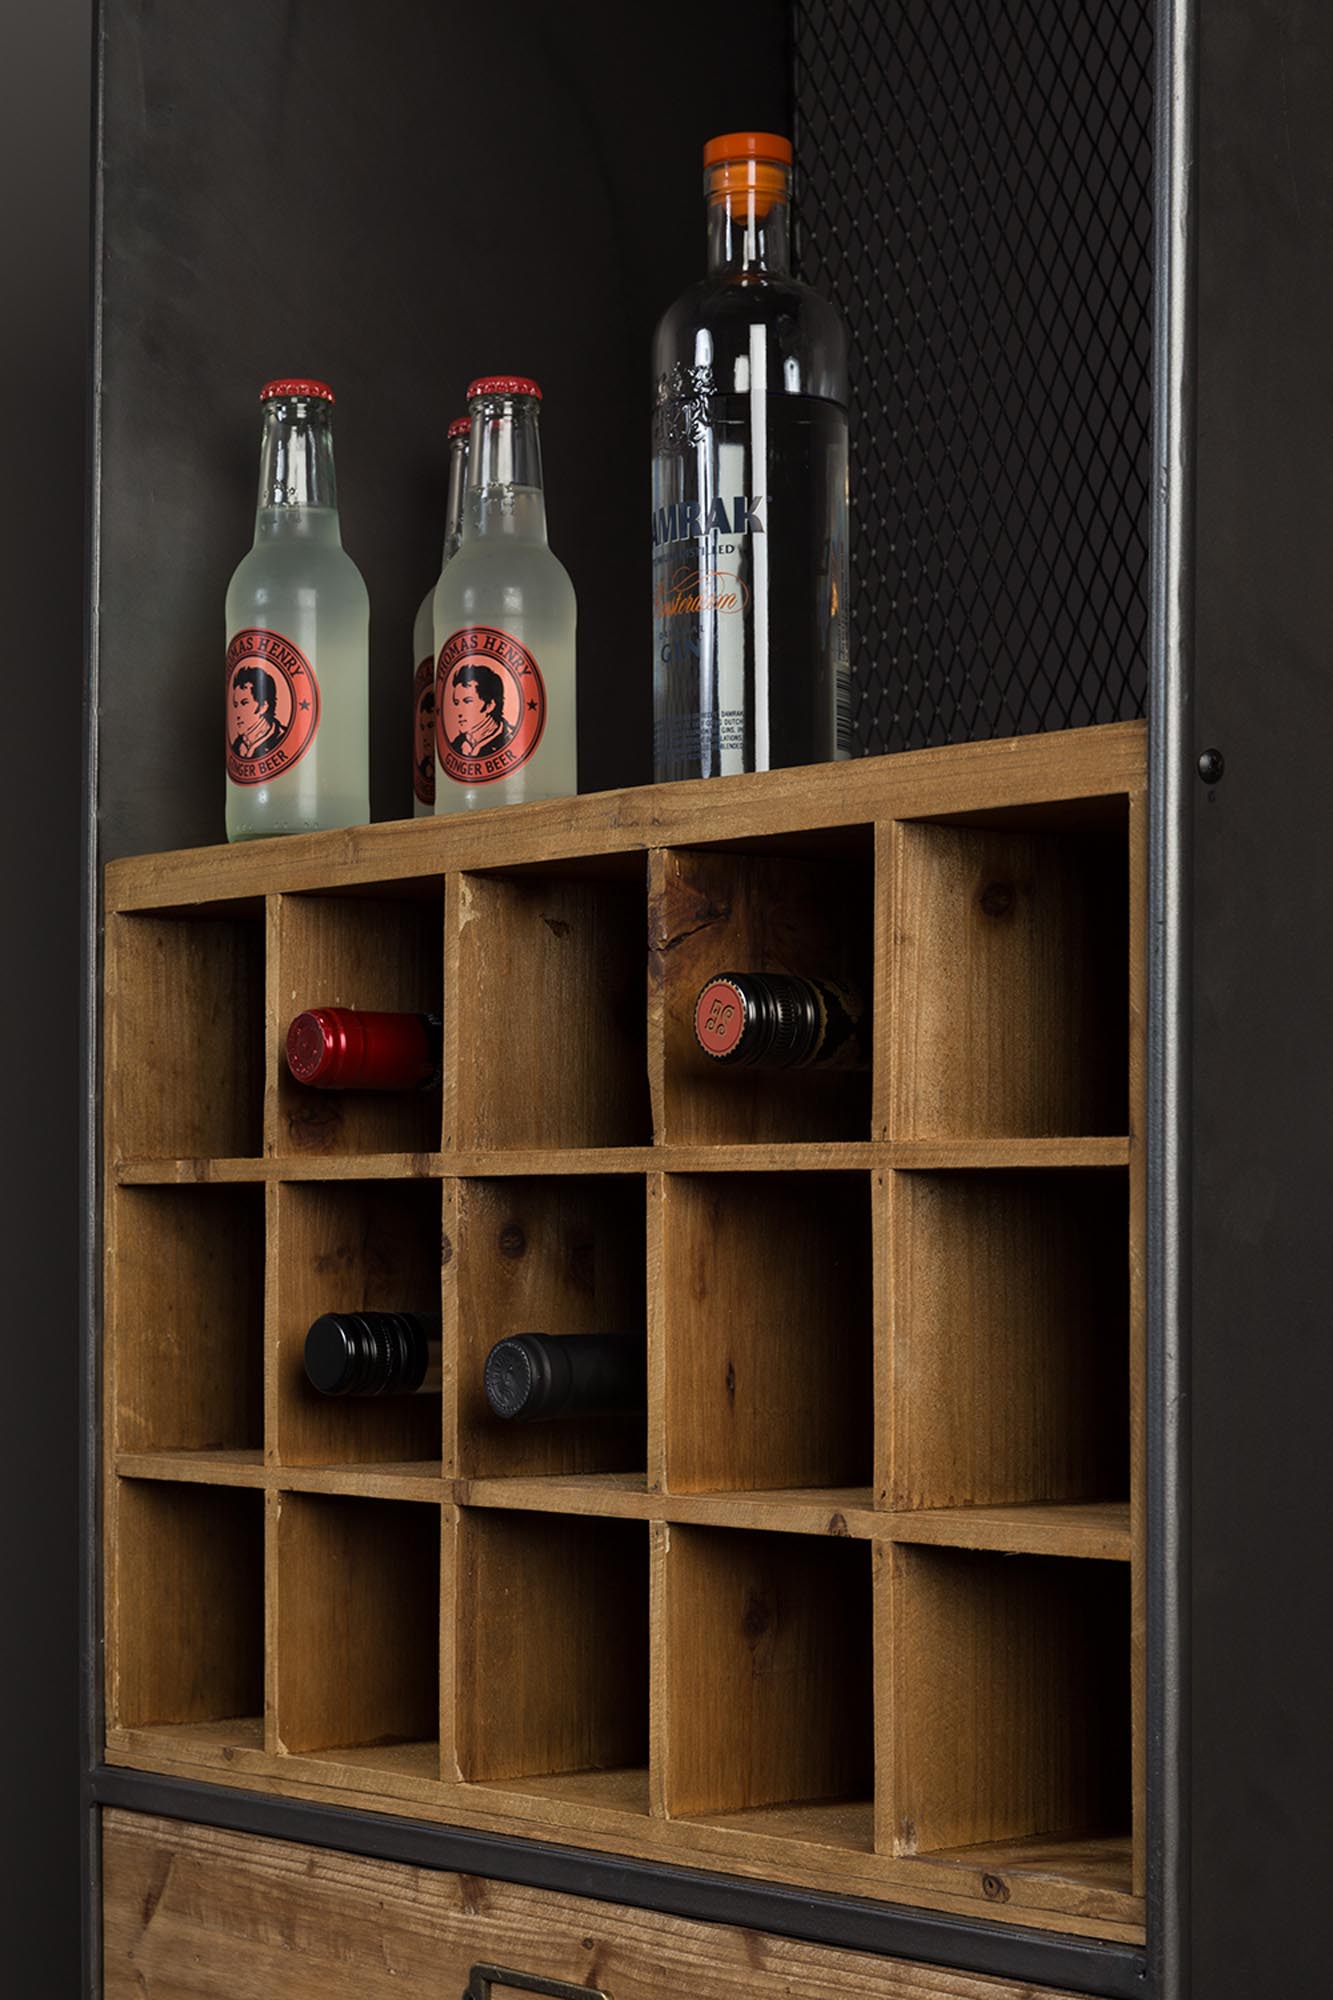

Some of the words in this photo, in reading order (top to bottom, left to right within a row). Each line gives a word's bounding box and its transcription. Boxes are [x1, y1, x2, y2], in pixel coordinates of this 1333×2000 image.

[258, 638, 304, 678] HENRY
[439, 635, 478, 681] THOMAS
[483, 636, 531, 677] HENRY
[258, 750, 289, 774] BEER
[446, 753, 482, 775] GINGER
[485, 750, 517, 773] BEER
